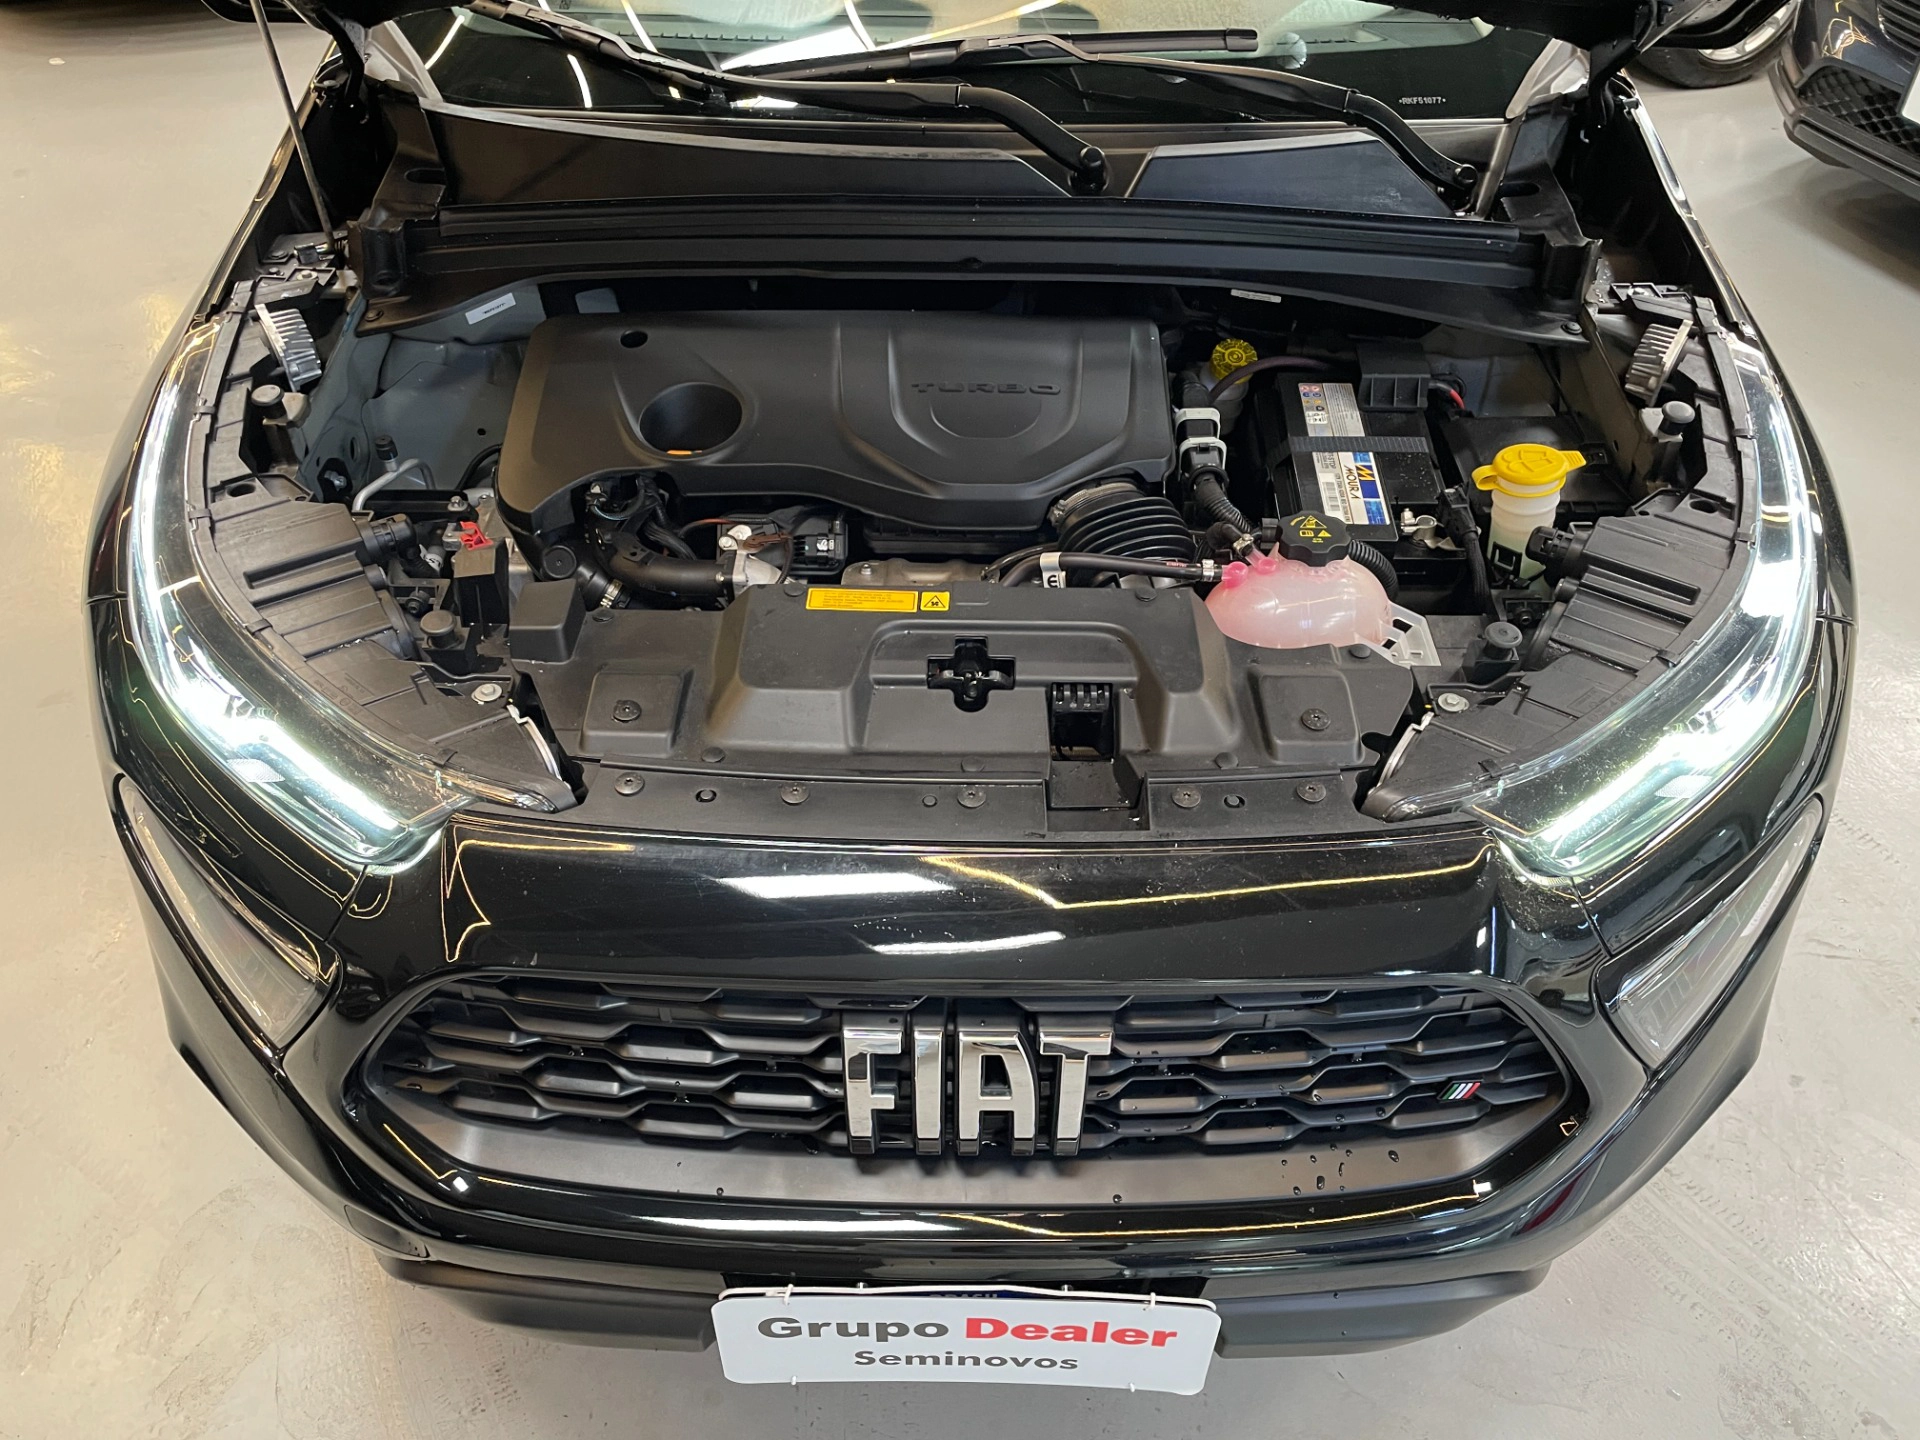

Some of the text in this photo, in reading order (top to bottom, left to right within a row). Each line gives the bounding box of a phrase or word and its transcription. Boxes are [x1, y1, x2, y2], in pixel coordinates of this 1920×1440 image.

[911, 382, 1061, 396] TURBO
[1344, 464, 1362, 500] MOURA
[843, 1029, 1112, 1154] FIAT
[758, 1317, 1178, 1347] Grupo Dealer
[854, 1350, 1079, 1370] Seminovos
